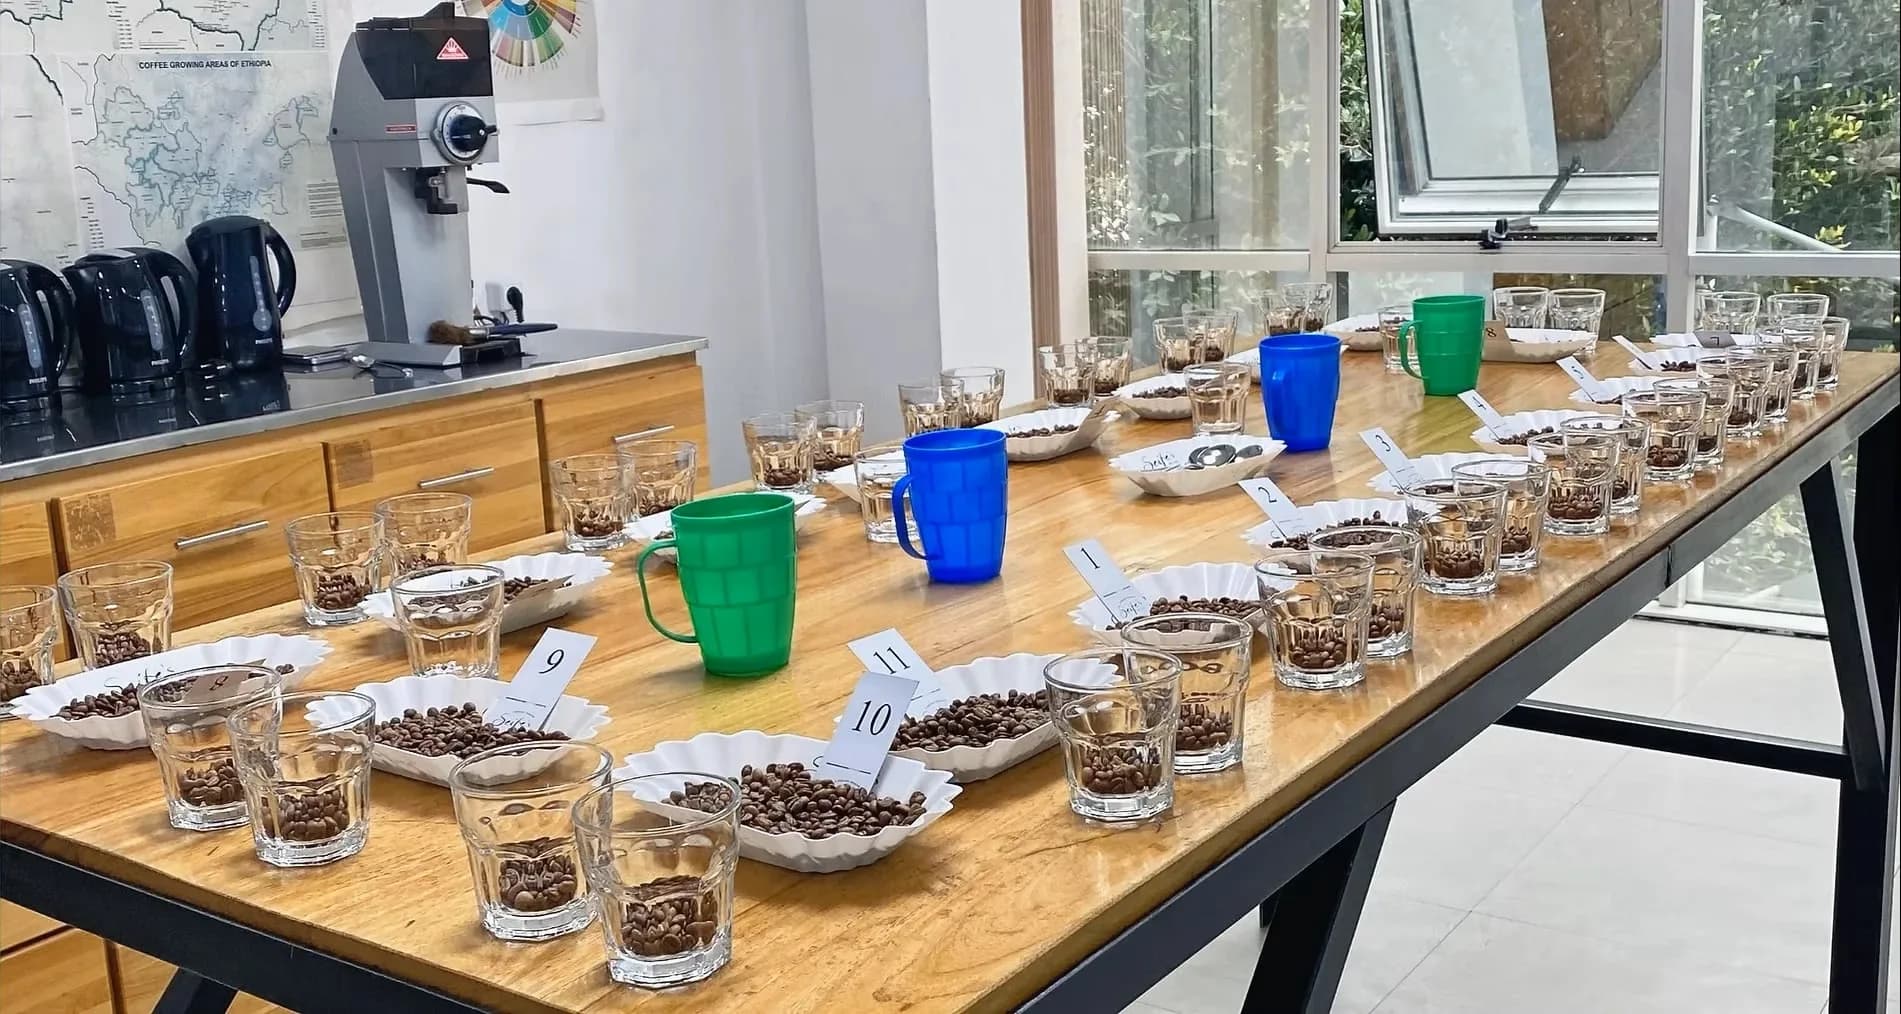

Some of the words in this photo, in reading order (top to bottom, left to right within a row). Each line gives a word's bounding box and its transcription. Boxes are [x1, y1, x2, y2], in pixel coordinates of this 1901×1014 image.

[139, 61, 168, 69] COFFEE
[169, 61, 204, 69] GROWING
[205, 60, 228, 69] AREAS
[230, 60, 240, 68] OF
[241, 60, 272, 68] ETHIOPIA
[1375, 434, 1391, 452] 3
[1258, 486, 1277, 503] 2
[1081, 547, 1101, 569] 1
[538, 649, 565, 674] 9
[873, 647, 911, 675] 11
[851, 700, 892, 736] 10
